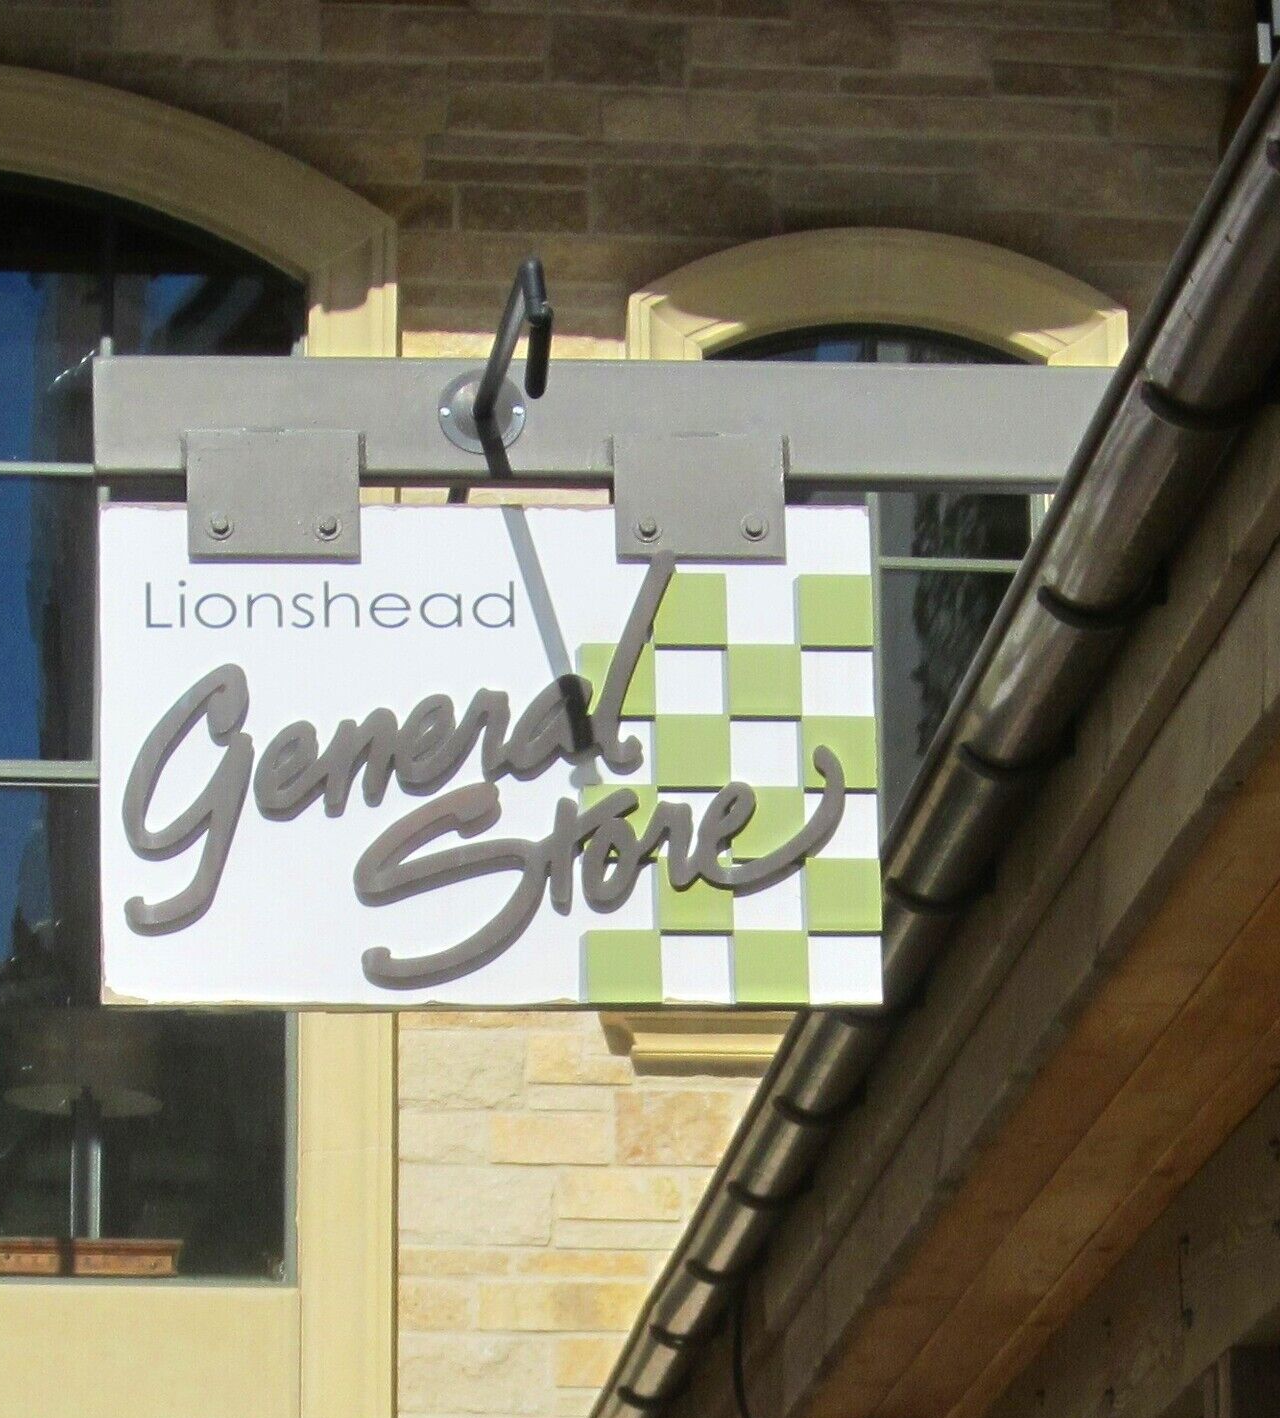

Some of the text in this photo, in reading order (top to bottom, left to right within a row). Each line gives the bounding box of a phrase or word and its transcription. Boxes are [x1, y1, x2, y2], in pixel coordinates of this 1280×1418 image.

[144, 579, 516, 629] Lionshead
[122, 551, 677, 937] General
[353, 746, 846, 990] Store
